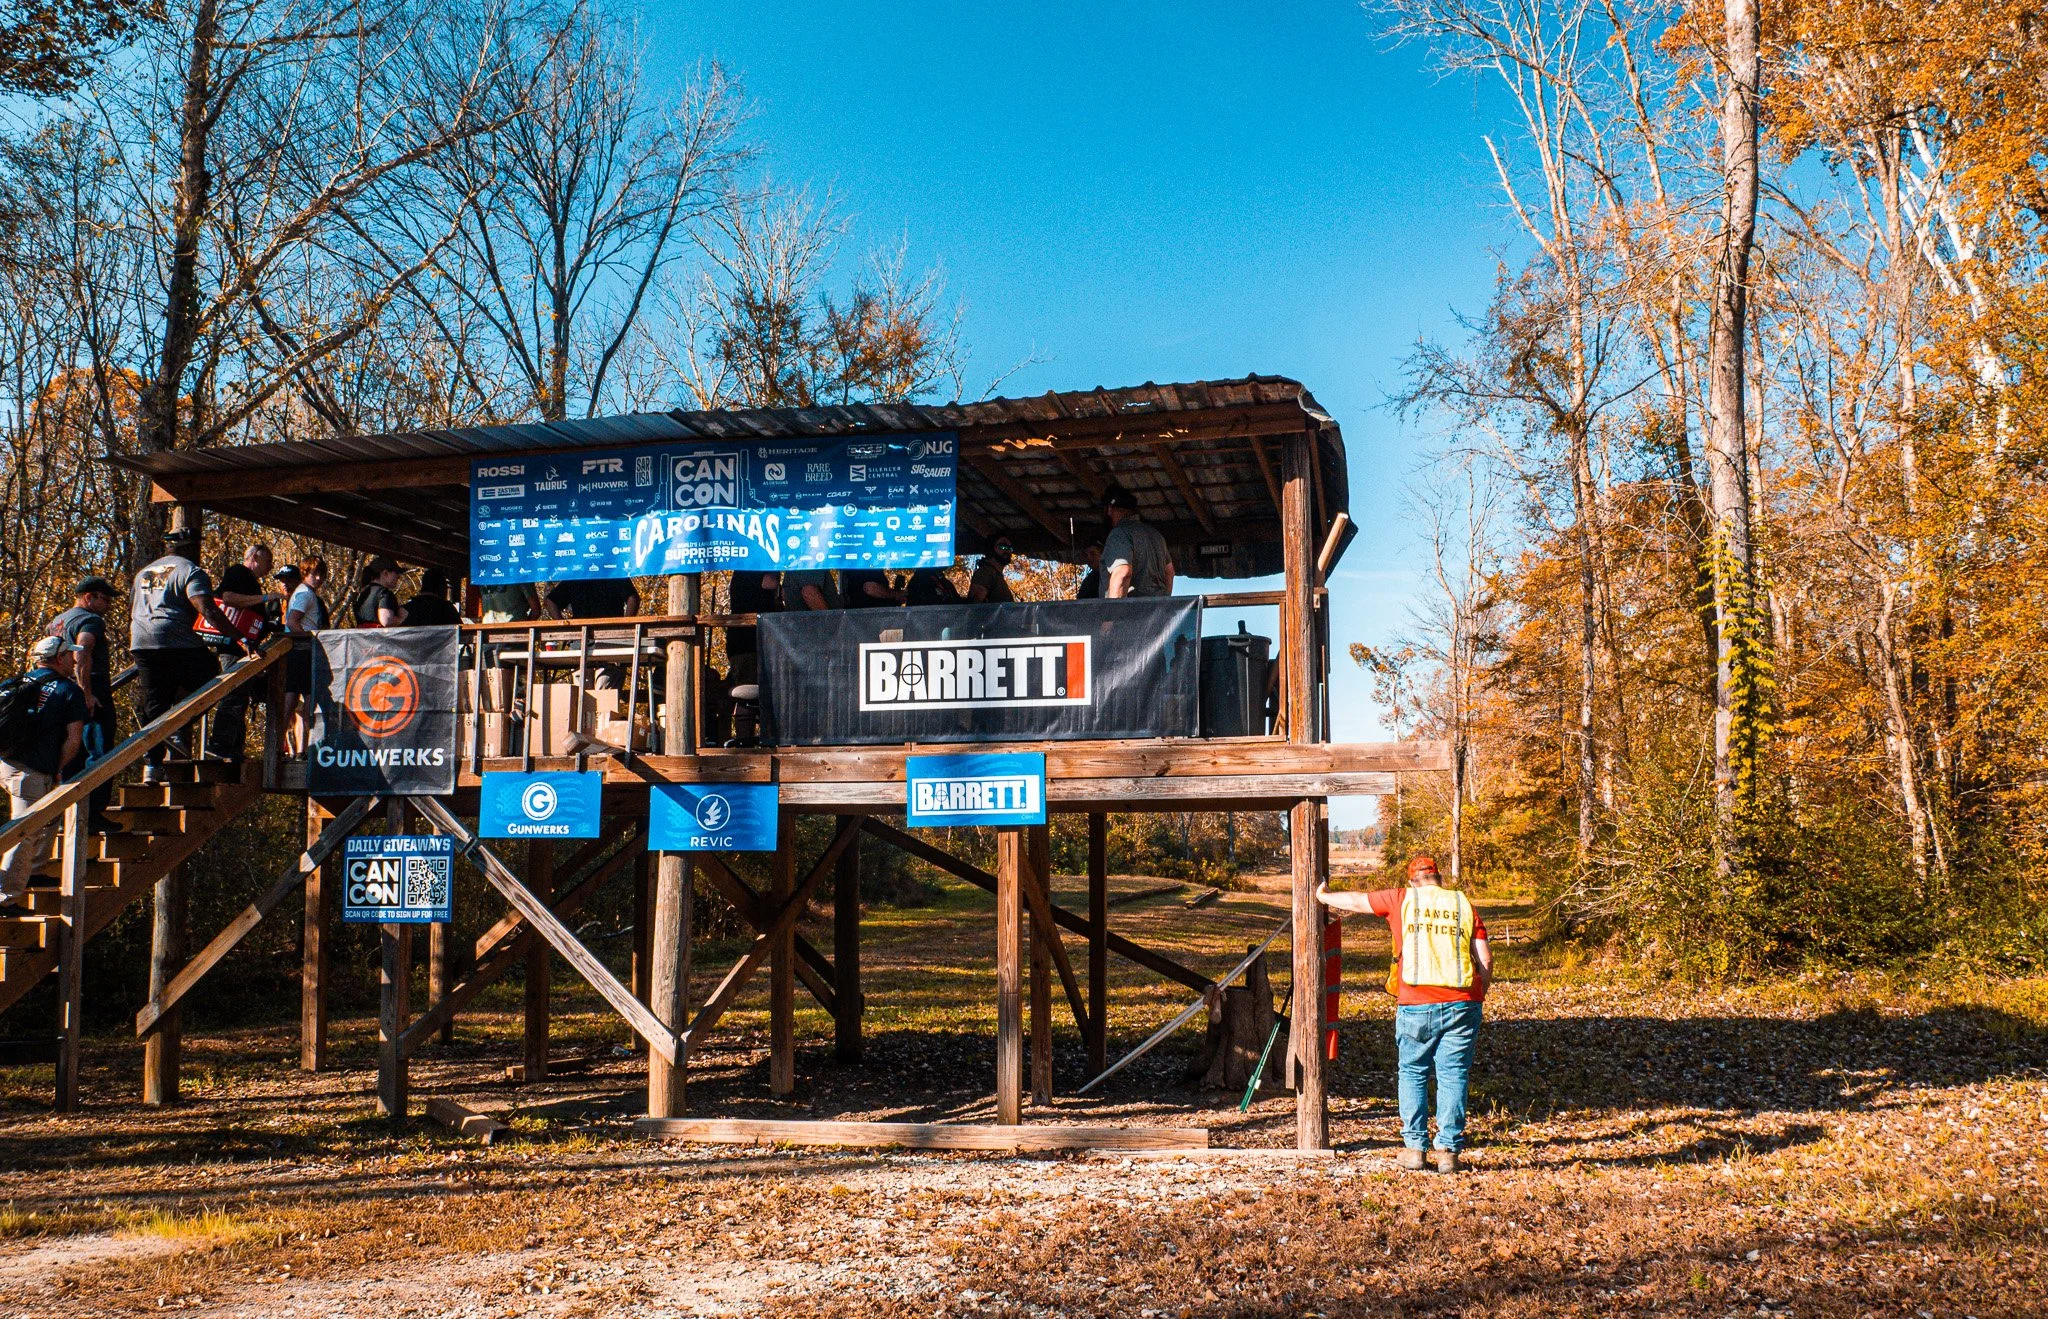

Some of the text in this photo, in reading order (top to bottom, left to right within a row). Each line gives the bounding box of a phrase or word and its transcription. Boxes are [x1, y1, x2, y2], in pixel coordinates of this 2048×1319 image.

[926, 441, 953, 455] NJG
[477, 465, 525, 478] ROSSI
[582, 458, 624, 475] PTR
[675, 458, 735, 483] CAN
[807, 463, 831, 473] RARE
[910, 464, 952, 478] SIG SAUER
[805, 473, 833, 482] BREED
[534, 480, 568, 492] TAURUS
[591, 481, 629, 490] HUXWRX
[675, 482, 735, 507] CON
[635, 513, 780, 568] CAROLINAS
[664, 546, 749, 561] SUPPRESSED
[869, 645, 1065, 702] BARRETT
[316, 746, 445, 768] GUNWERKS
[916, 780, 1026, 812] BARRETT
[507, 823, 570, 835] GUNWERKS
[347, 838, 451, 853] DAILY GIVEAWAYS
[690, 836, 733, 848] REVIC
[350, 861, 400, 883] CAN
[349, 883, 399, 905] CON
[361, 911, 370, 919] QR
[371, 911, 387, 919] CODE
[434, 911, 448, 919] FREE
[1414, 907, 1460, 921] RANGE
[1407, 923, 1465, 938] OFFICER
